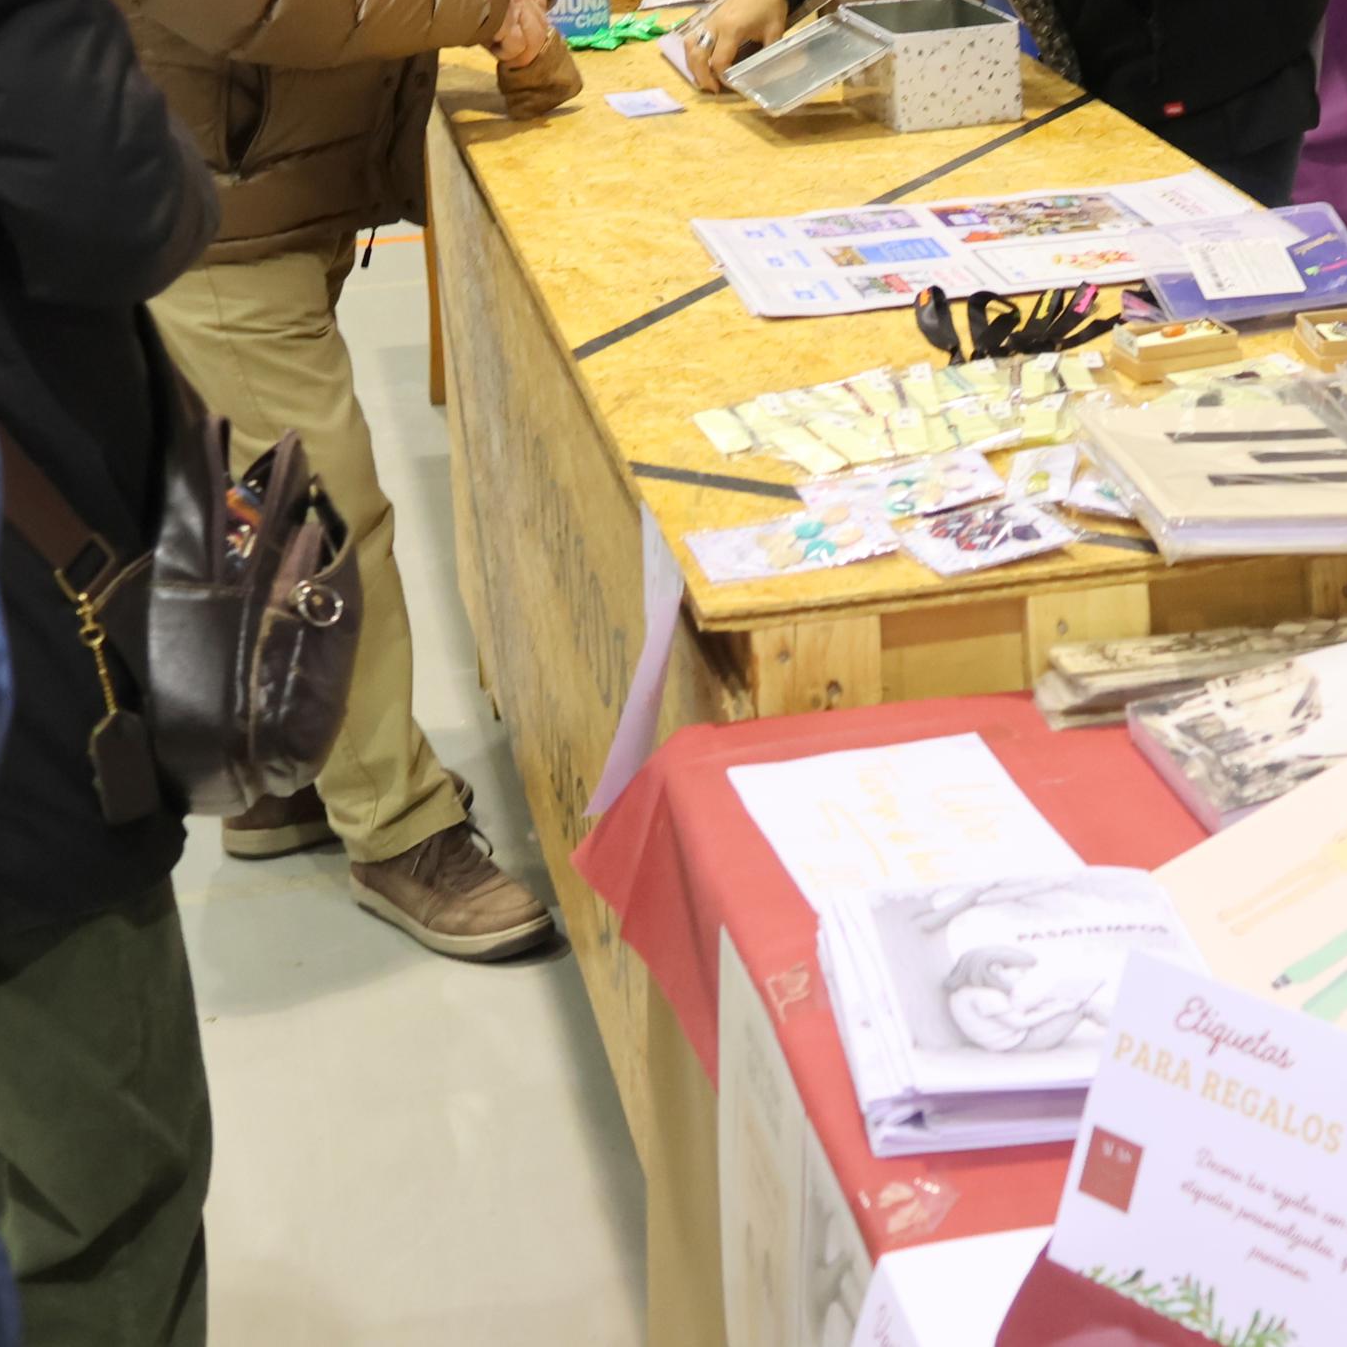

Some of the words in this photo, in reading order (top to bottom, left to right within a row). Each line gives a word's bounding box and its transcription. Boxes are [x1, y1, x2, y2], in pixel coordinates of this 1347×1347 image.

[1016, 924, 1169, 942] PASATIEMPOS
[1173, 996, 1296, 1071] Etiquetas
[1112, 1032, 1193, 1091] PARA
[1199, 1069, 1345, 1154] REGALOS
[1322, 1212, 1346, 1229] con
